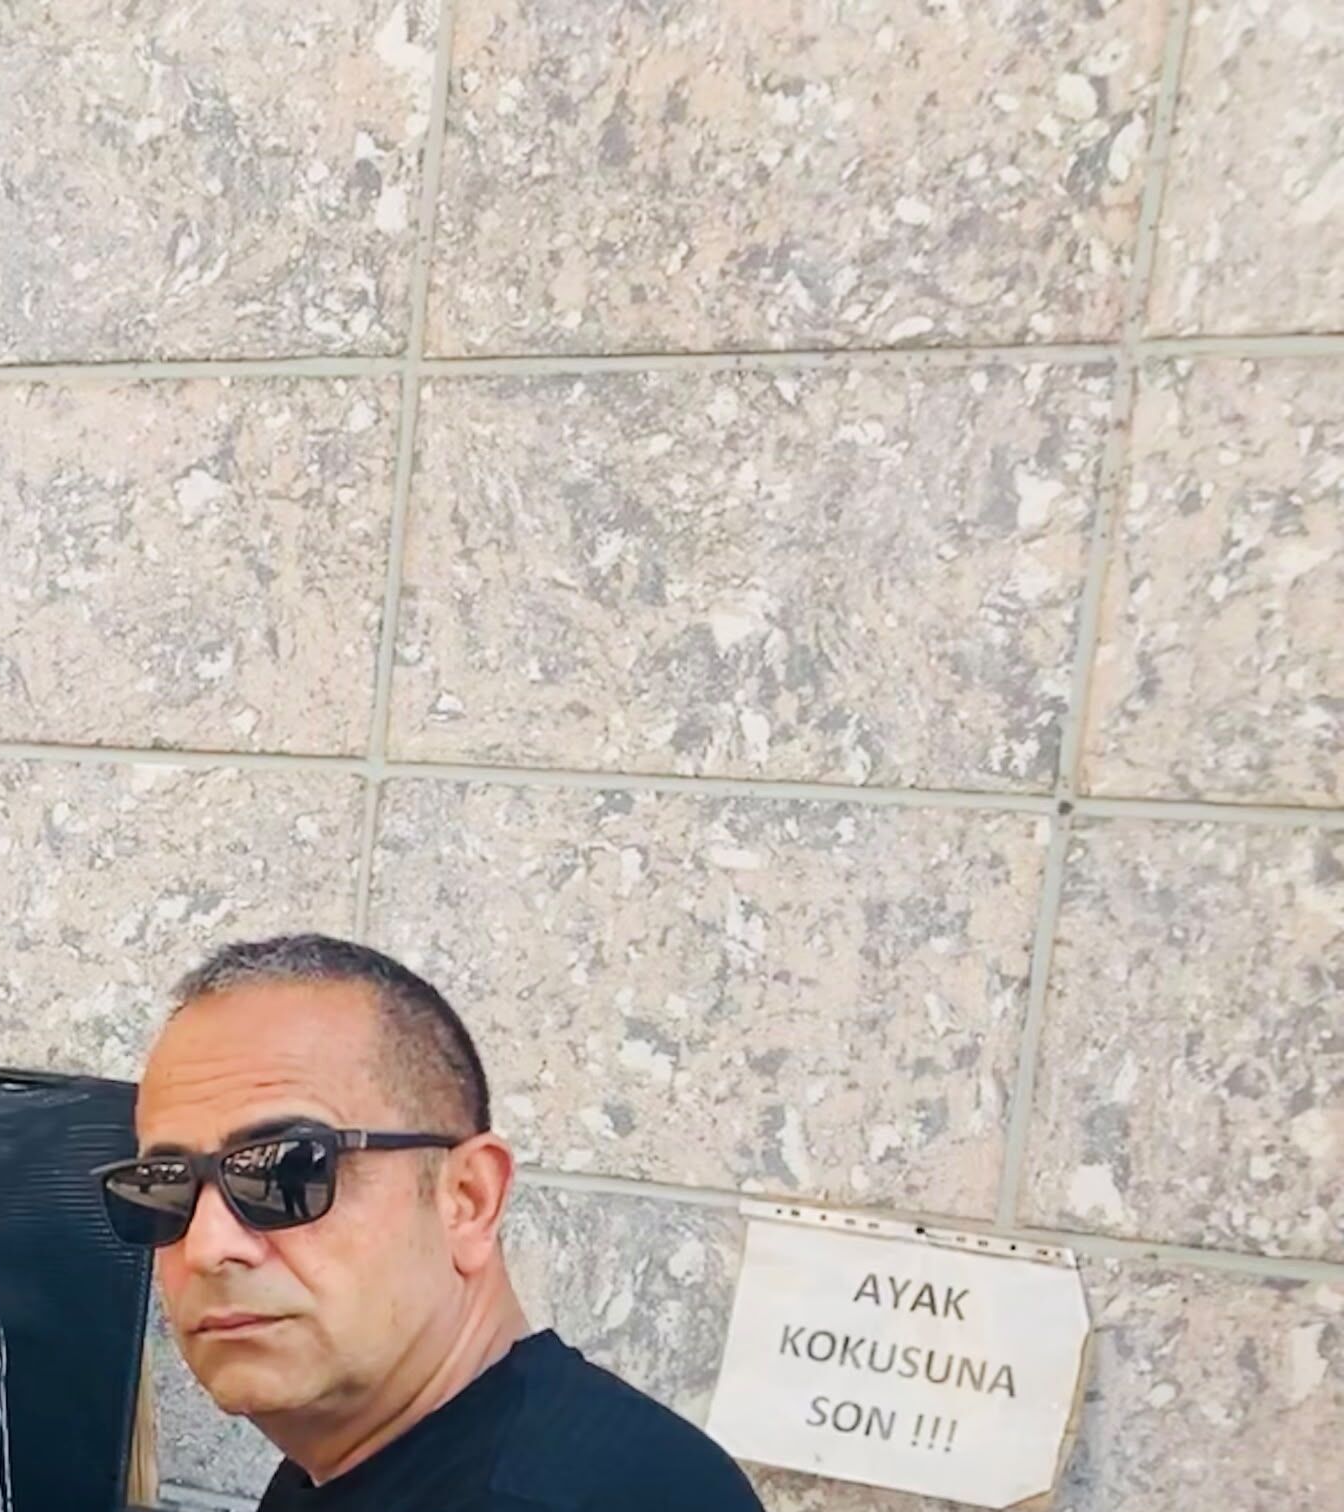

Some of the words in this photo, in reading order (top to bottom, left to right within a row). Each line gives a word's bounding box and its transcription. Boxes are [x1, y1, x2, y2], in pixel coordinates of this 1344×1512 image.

[852, 1272, 970, 1321] AYAK
[779, 1324, 1017, 1399] KOKUSUNA
[805, 1395, 896, 1441] SON
[911, 1413, 959, 1454] !!!
